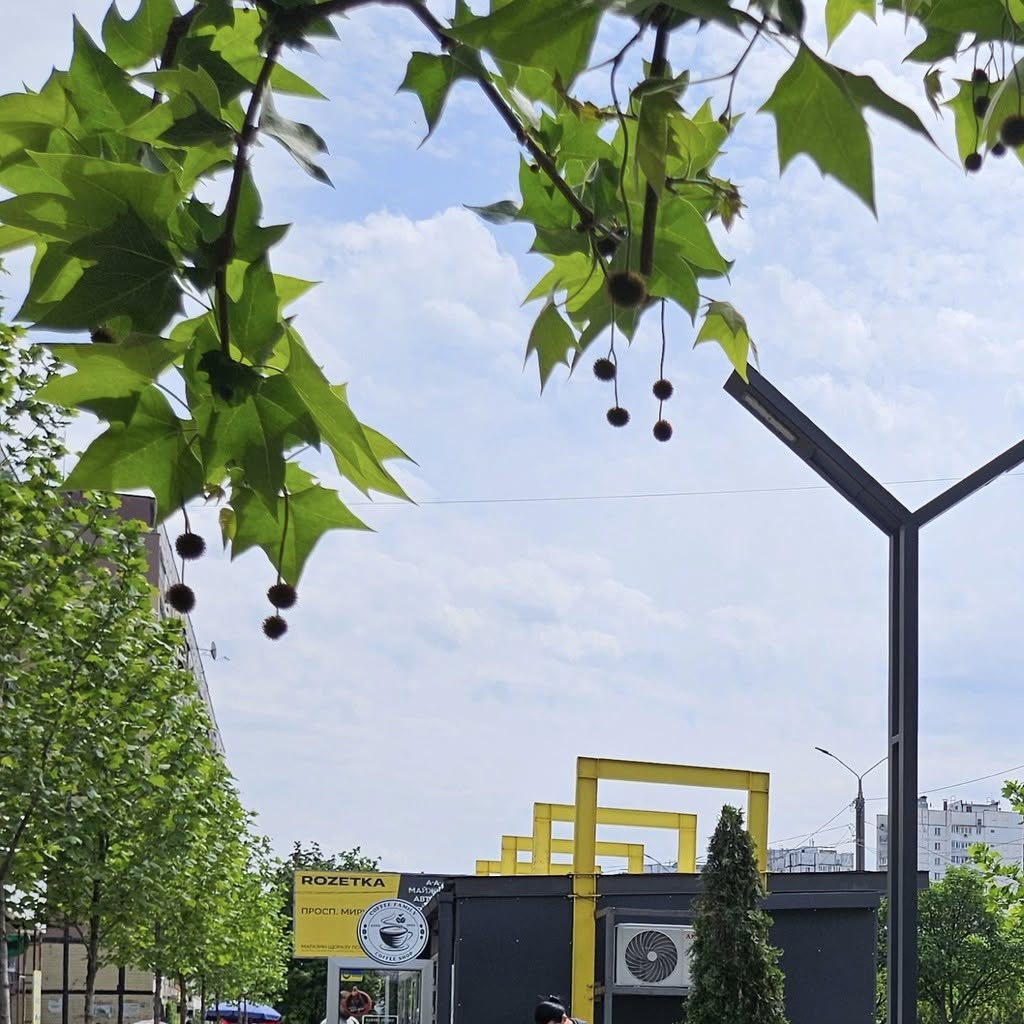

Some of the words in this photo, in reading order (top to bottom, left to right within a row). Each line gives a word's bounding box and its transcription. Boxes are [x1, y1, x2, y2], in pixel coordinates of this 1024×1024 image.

[301, 875, 385, 888] ROZETKA
[301, 907, 339, 916] ПРОСП.
[340, 908, 365, 916] МИР
[369, 903, 391, 916] COFFEE
[393, 903, 417, 916] FAMILY
[374, 951, 396, 961] COFFEE
[398, 951, 413, 961] SHOP
